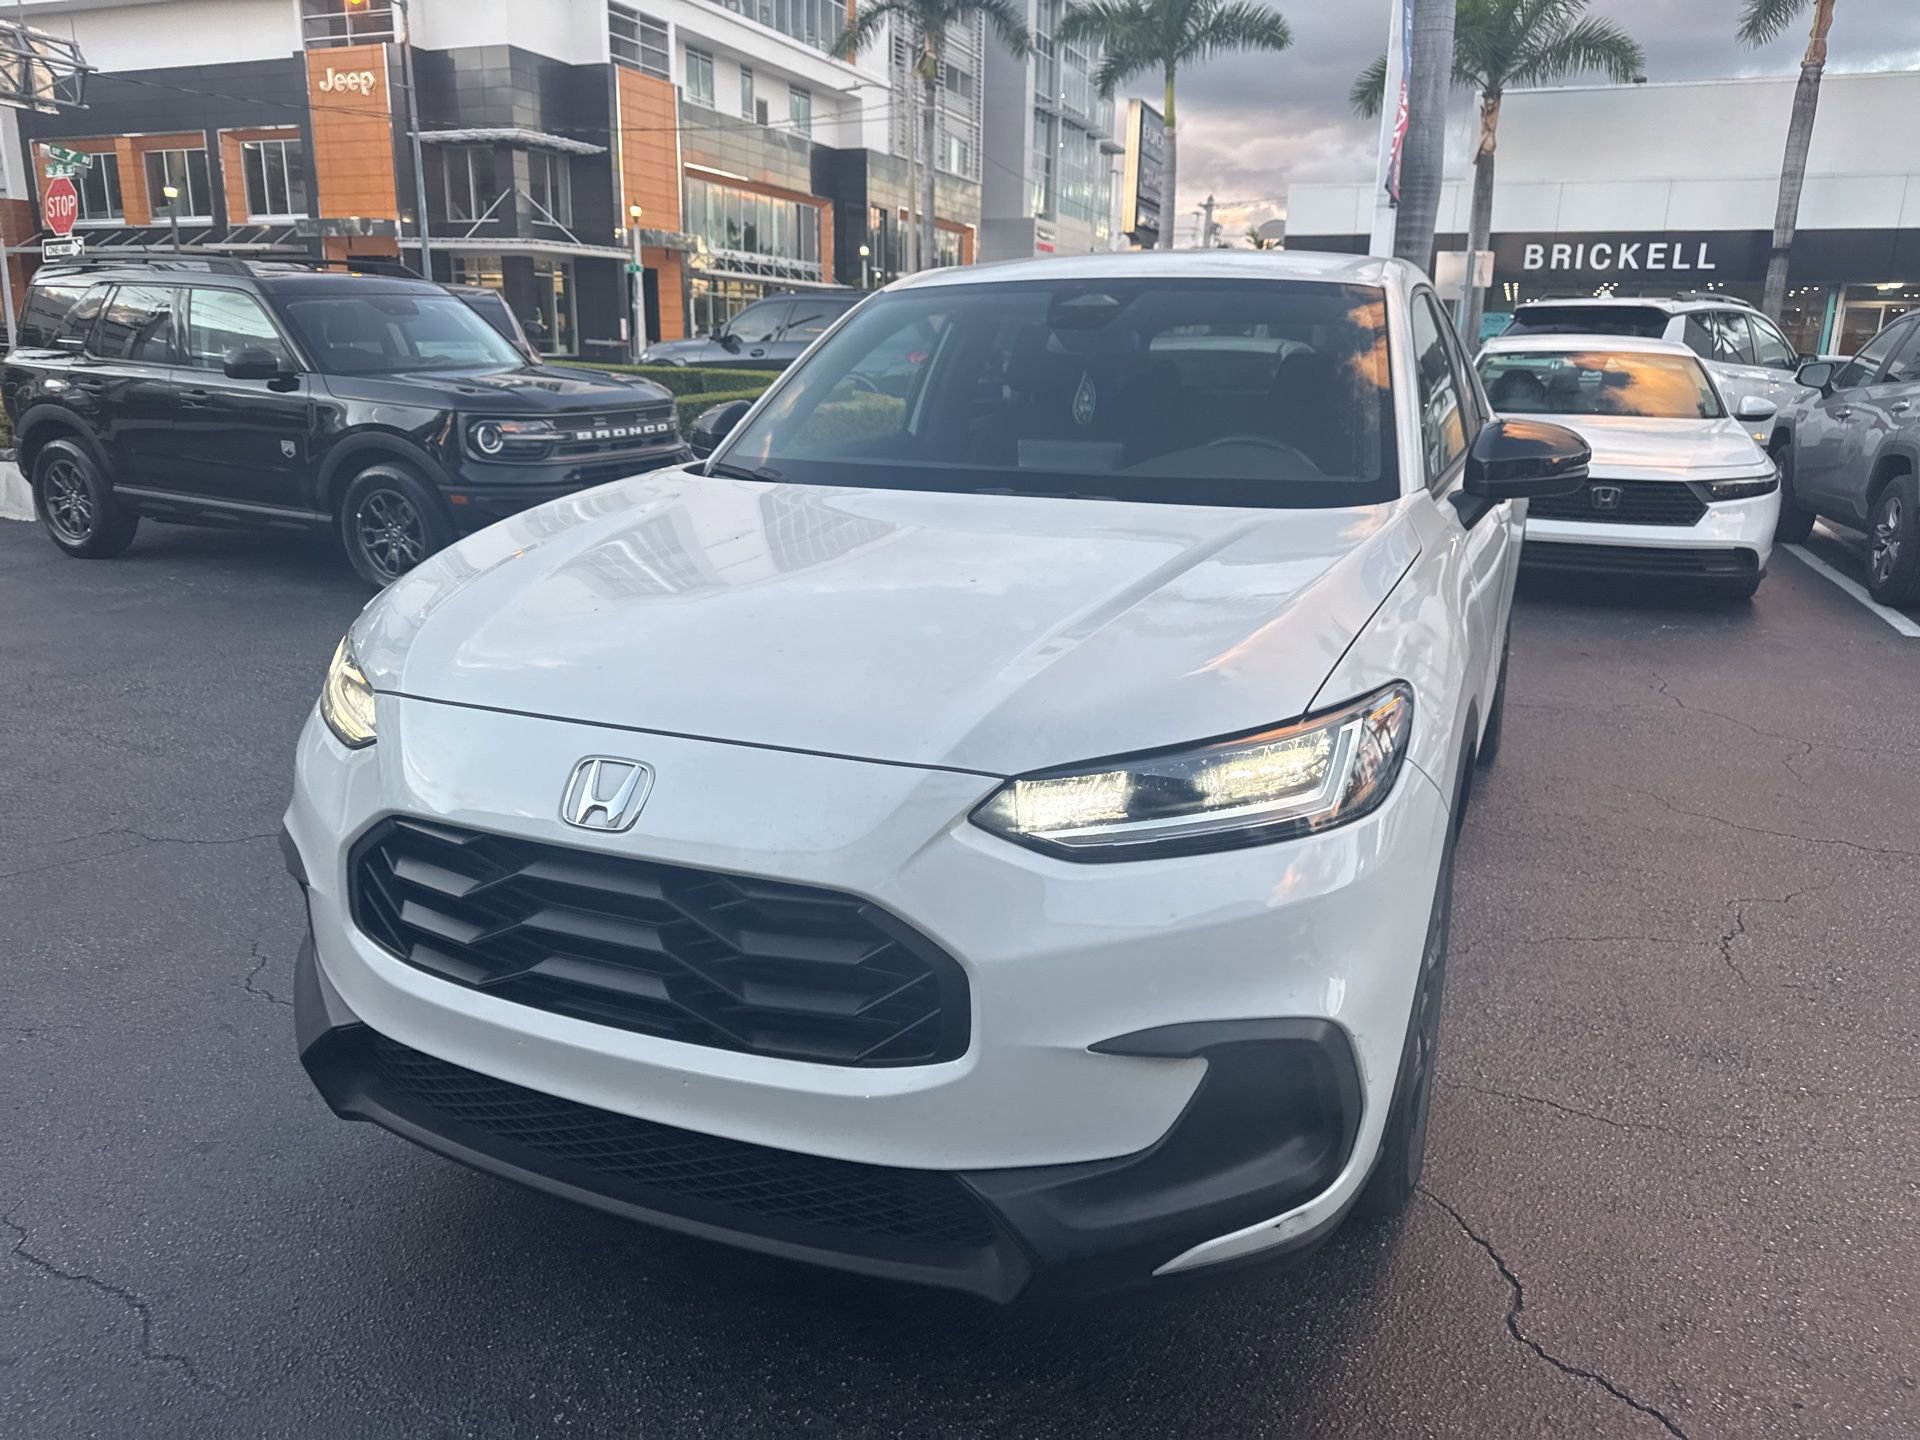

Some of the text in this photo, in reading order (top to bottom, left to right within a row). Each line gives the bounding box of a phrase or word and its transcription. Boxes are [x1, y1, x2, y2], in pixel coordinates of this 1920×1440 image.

[319, 67, 375, 96] Jeep
[48, 194, 76, 218] STOP
[1523, 242, 1716, 271] BRICKELL
[576, 423, 668, 441] BRONCO
